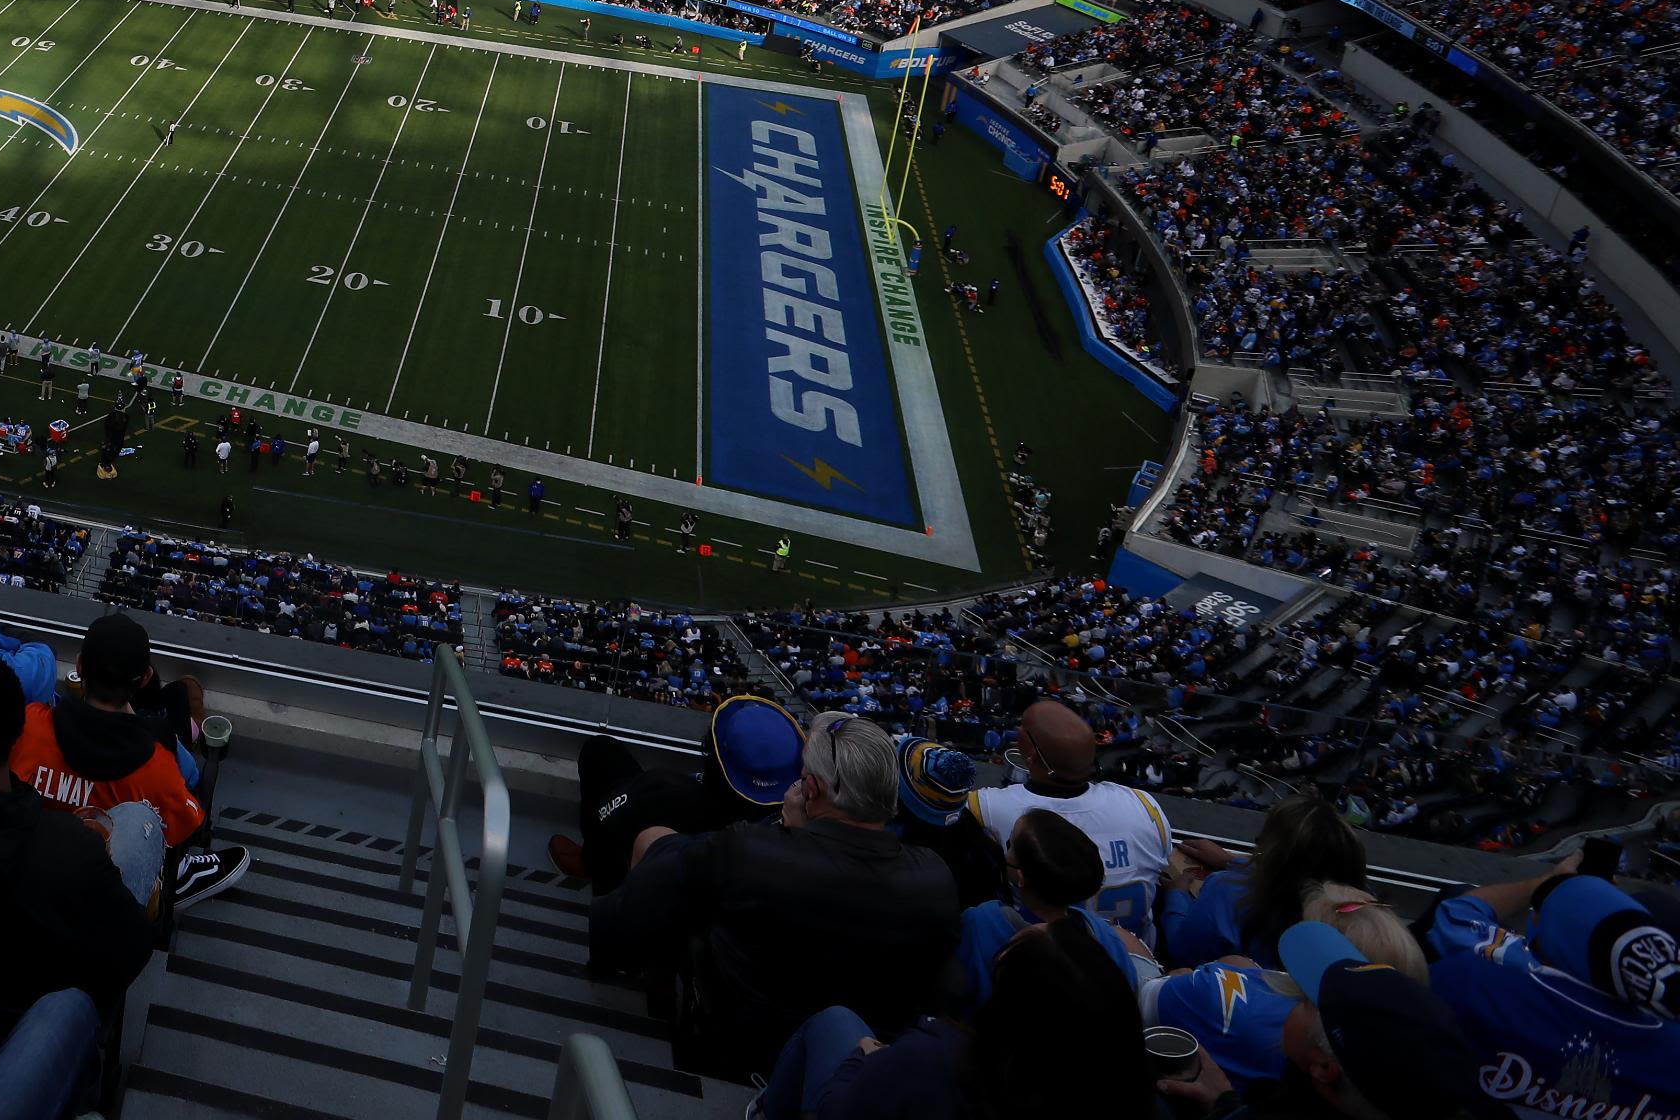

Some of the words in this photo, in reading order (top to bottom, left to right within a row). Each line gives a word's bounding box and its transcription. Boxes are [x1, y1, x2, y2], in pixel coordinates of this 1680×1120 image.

[1050, 176, 1069, 200] 5:01
[144, 234, 205, 259] 30
[306, 265, 369, 291] 20
[712, 119, 863, 448] CHARGERS
[483, 298, 544, 326] 10
[882, 272, 920, 347] CHANGE
[199, 379, 364, 431] CHANGE
[34, 764, 95, 809] ELWAY
[1104, 839, 1130, 869] JR
